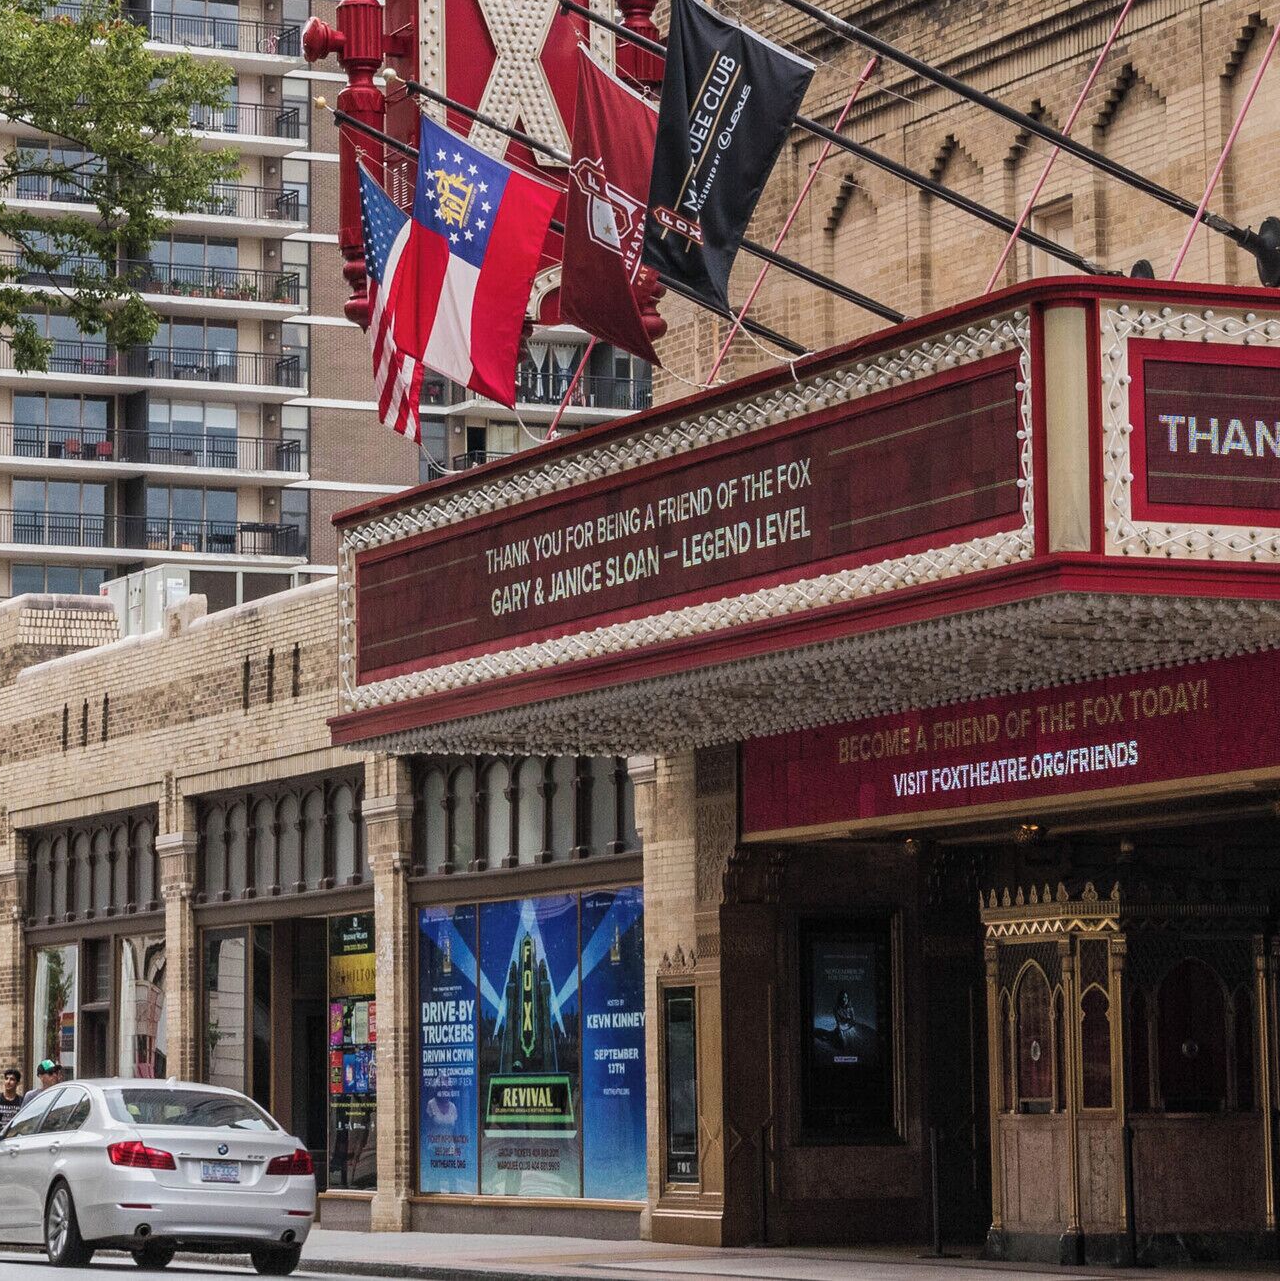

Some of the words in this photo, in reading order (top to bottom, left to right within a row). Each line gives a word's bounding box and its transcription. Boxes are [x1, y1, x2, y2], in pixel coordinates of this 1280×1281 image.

[702, 54, 736, 111] CLUB
[727, 84, 752, 133] LEXUS
[696, 165, 718, 211] RESENTED
[714, 152, 721, 167] BY
[660, 211, 703, 240] FOX
[486, 540, 531, 574] THANK
[533, 532, 562, 561] YOU
[566, 521, 594, 553] FOR
[597, 508, 641, 545] BEING
[644, 503, 656, 531] A
[658, 487, 713, 527] FRIEND
[716, 479, 738, 509] OF
[741, 469, 773, 503] THE
[777, 458, 812, 495] FOX
[491, 580, 531, 616] GARY
[534, 577, 546, 605] &
[548, 561, 602, 603] JANICE
[605, 545, 660, 588] SLOAN
[682, 521, 751, 568] LEGEND
[756, 506, 811, 548] LEVEL
[839, 727, 910, 764] BECOME
[916, 725, 927, 751] A
[932, 714, 1000, 751] FRIEND
[1005, 709, 1030, 740] OF
[1036, 701, 1075, 735] THE
[1082, 694, 1124, 728] FOX
[1129, 679, 1209, 720] TODAY!
[893, 769, 928, 798] VISIT
[931, 740, 1138, 794] FOXTHEATRE.ORG/FRIENDS
[523, 945, 532, 1031] FOX
[422, 1000, 475, 1024] DRIVE-BY
[587, 1013, 611, 1029] KEVN
[612, 1012, 646, 1028] KINNEY
[422, 1023, 475, 1044] TRUCKERS
[422, 1049, 446, 1064] DRIVIN
[446, 1049, 452, 1063] N
[452, 1048, 474, 1062] CRYIN
[594, 1048, 639, 1060] SEPTEMBER
[608, 1063, 625, 1074] 13TH
[503, 1088, 553, 1107] REVIVAL
[677, 1162, 690, 1173] FOX
